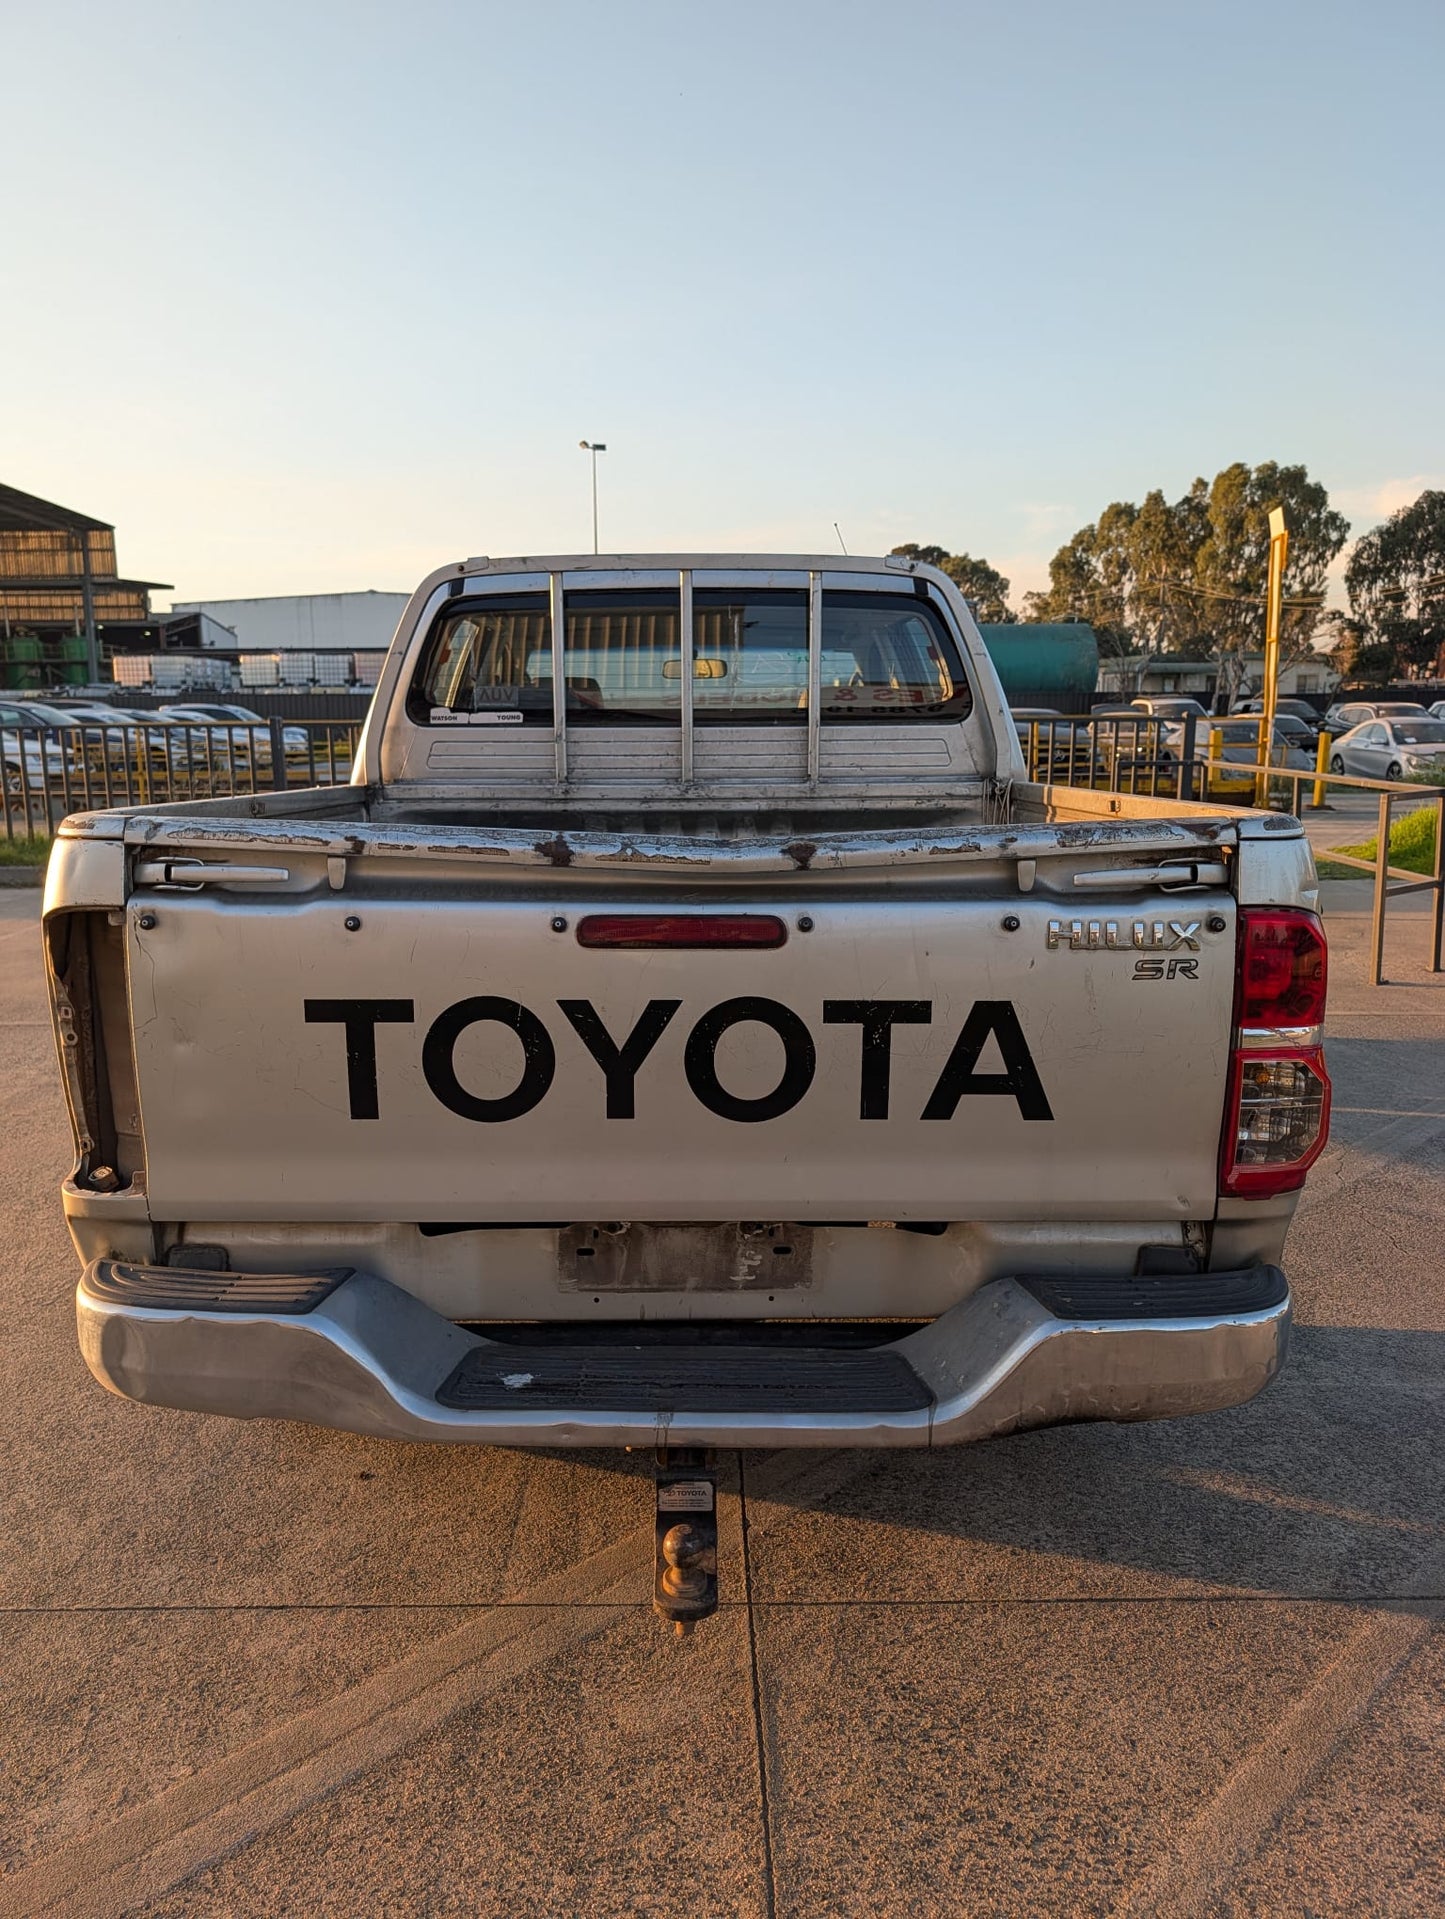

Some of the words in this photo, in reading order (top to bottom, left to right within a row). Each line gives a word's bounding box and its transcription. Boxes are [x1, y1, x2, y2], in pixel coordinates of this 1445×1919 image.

[1047, 920, 1201, 951] HILUX
[1132, 959, 1199, 980] SR
[304, 995, 1054, 1123] TOYOTA
